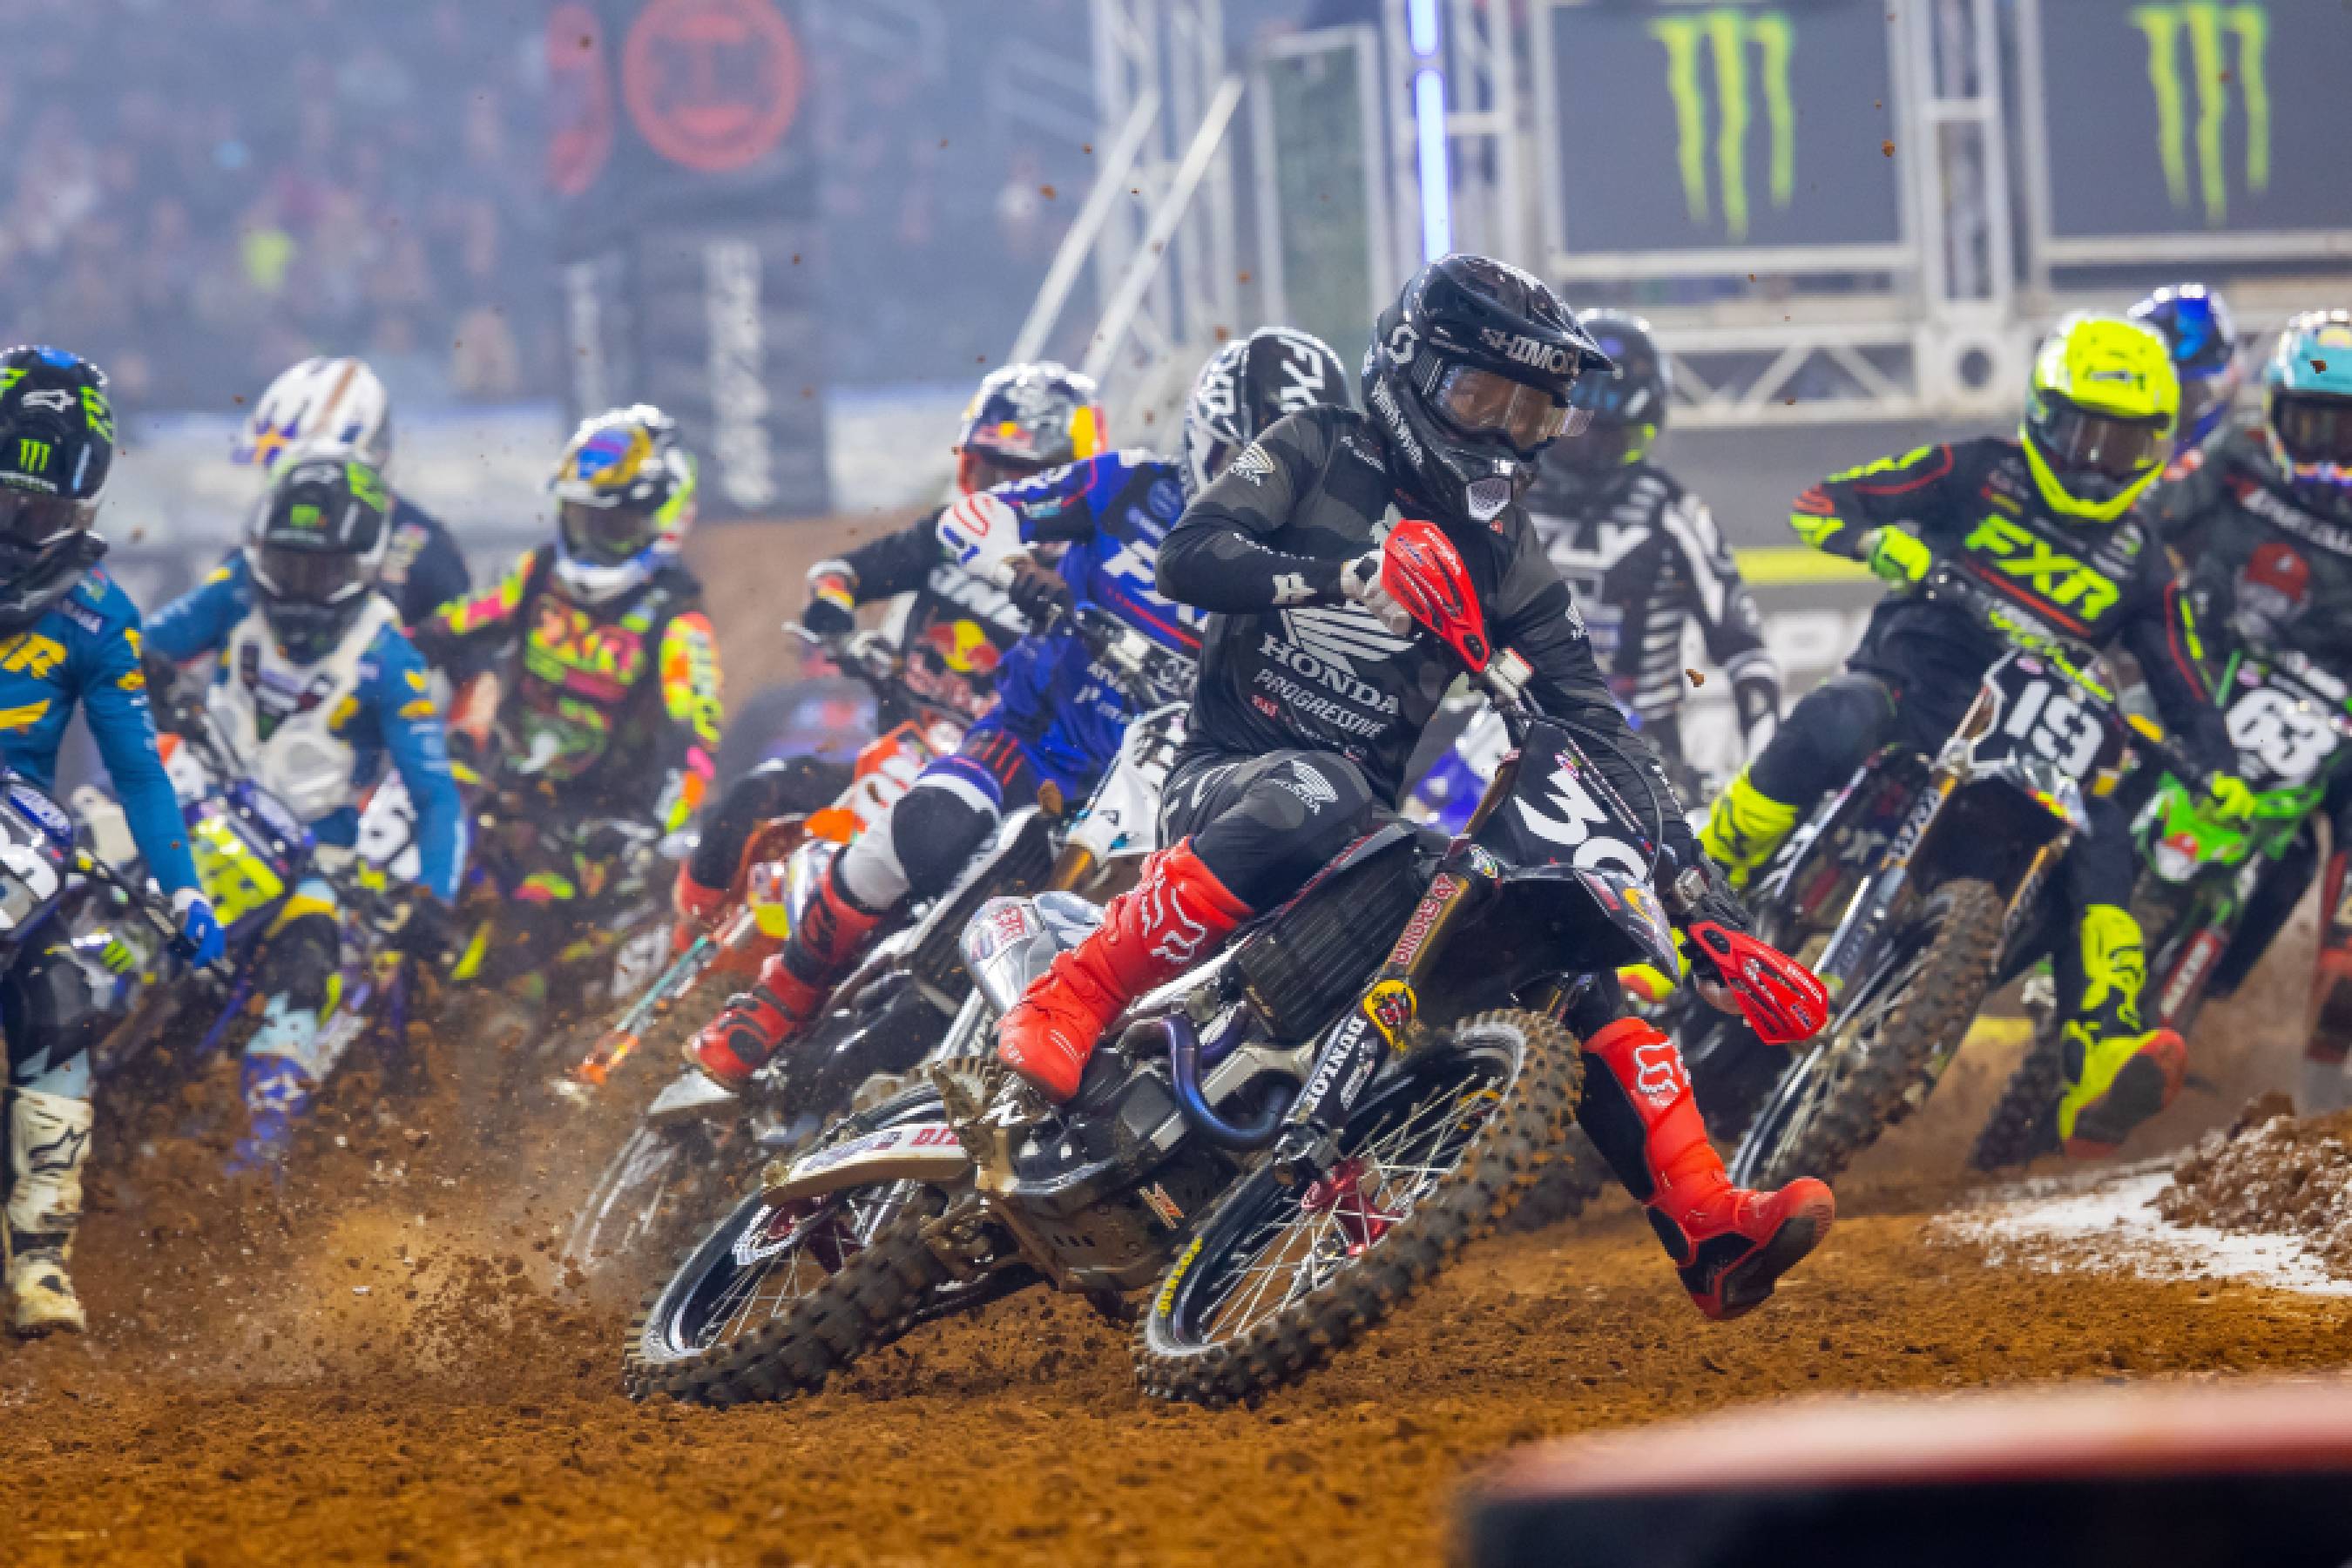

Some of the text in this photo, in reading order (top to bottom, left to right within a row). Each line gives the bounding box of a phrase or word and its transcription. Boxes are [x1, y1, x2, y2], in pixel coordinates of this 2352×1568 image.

[1965, 514, 2119, 620] FXR
[1259, 633, 1398, 715] HONDA
[2004, 681, 2103, 780] 19
